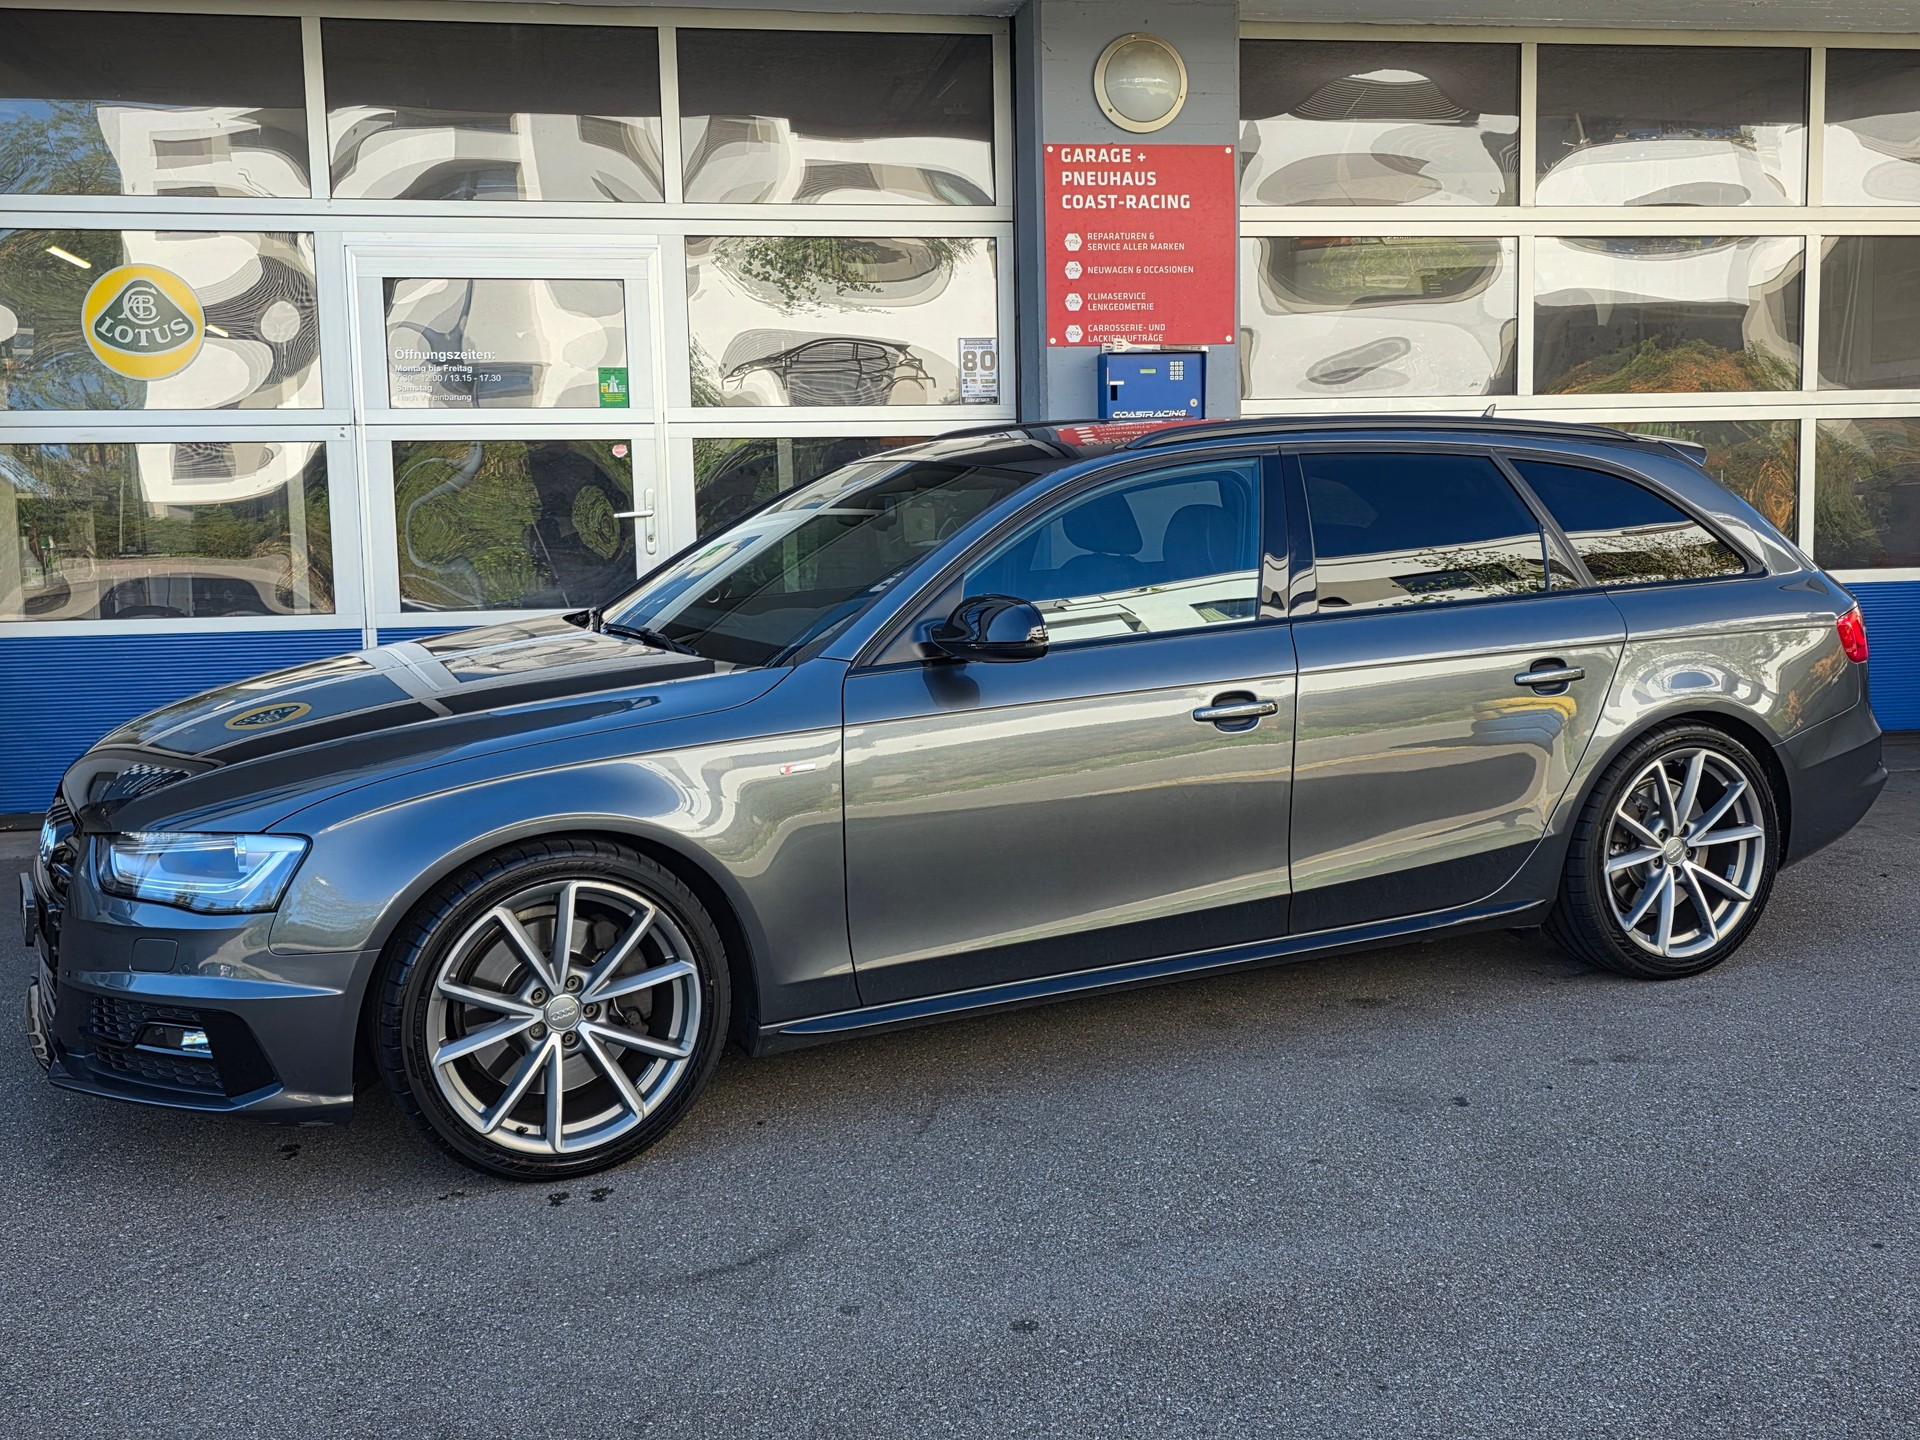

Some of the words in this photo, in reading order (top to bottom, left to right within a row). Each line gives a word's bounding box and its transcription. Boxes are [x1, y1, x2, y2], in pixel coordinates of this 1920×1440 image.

[1061, 148, 1132, 162] GARAGE
[1137, 153, 1146, 162] +
[1062, 172, 1157, 186] PNEUHAUS
[1062, 194, 1191, 209] COAST-RACING
[1088, 302, 1154, 310] LENKGEOMETRIE
[98, 317, 189, 346] LOTUS
[1088, 324, 1146, 332] CARROSSERIE-
[394, 348, 496, 361] Öffnungszeiten:
[962, 350, 996, 371] 80
[395, 365, 426, 373] Montag
[420, 394, 472, 402] Vereinbarung
